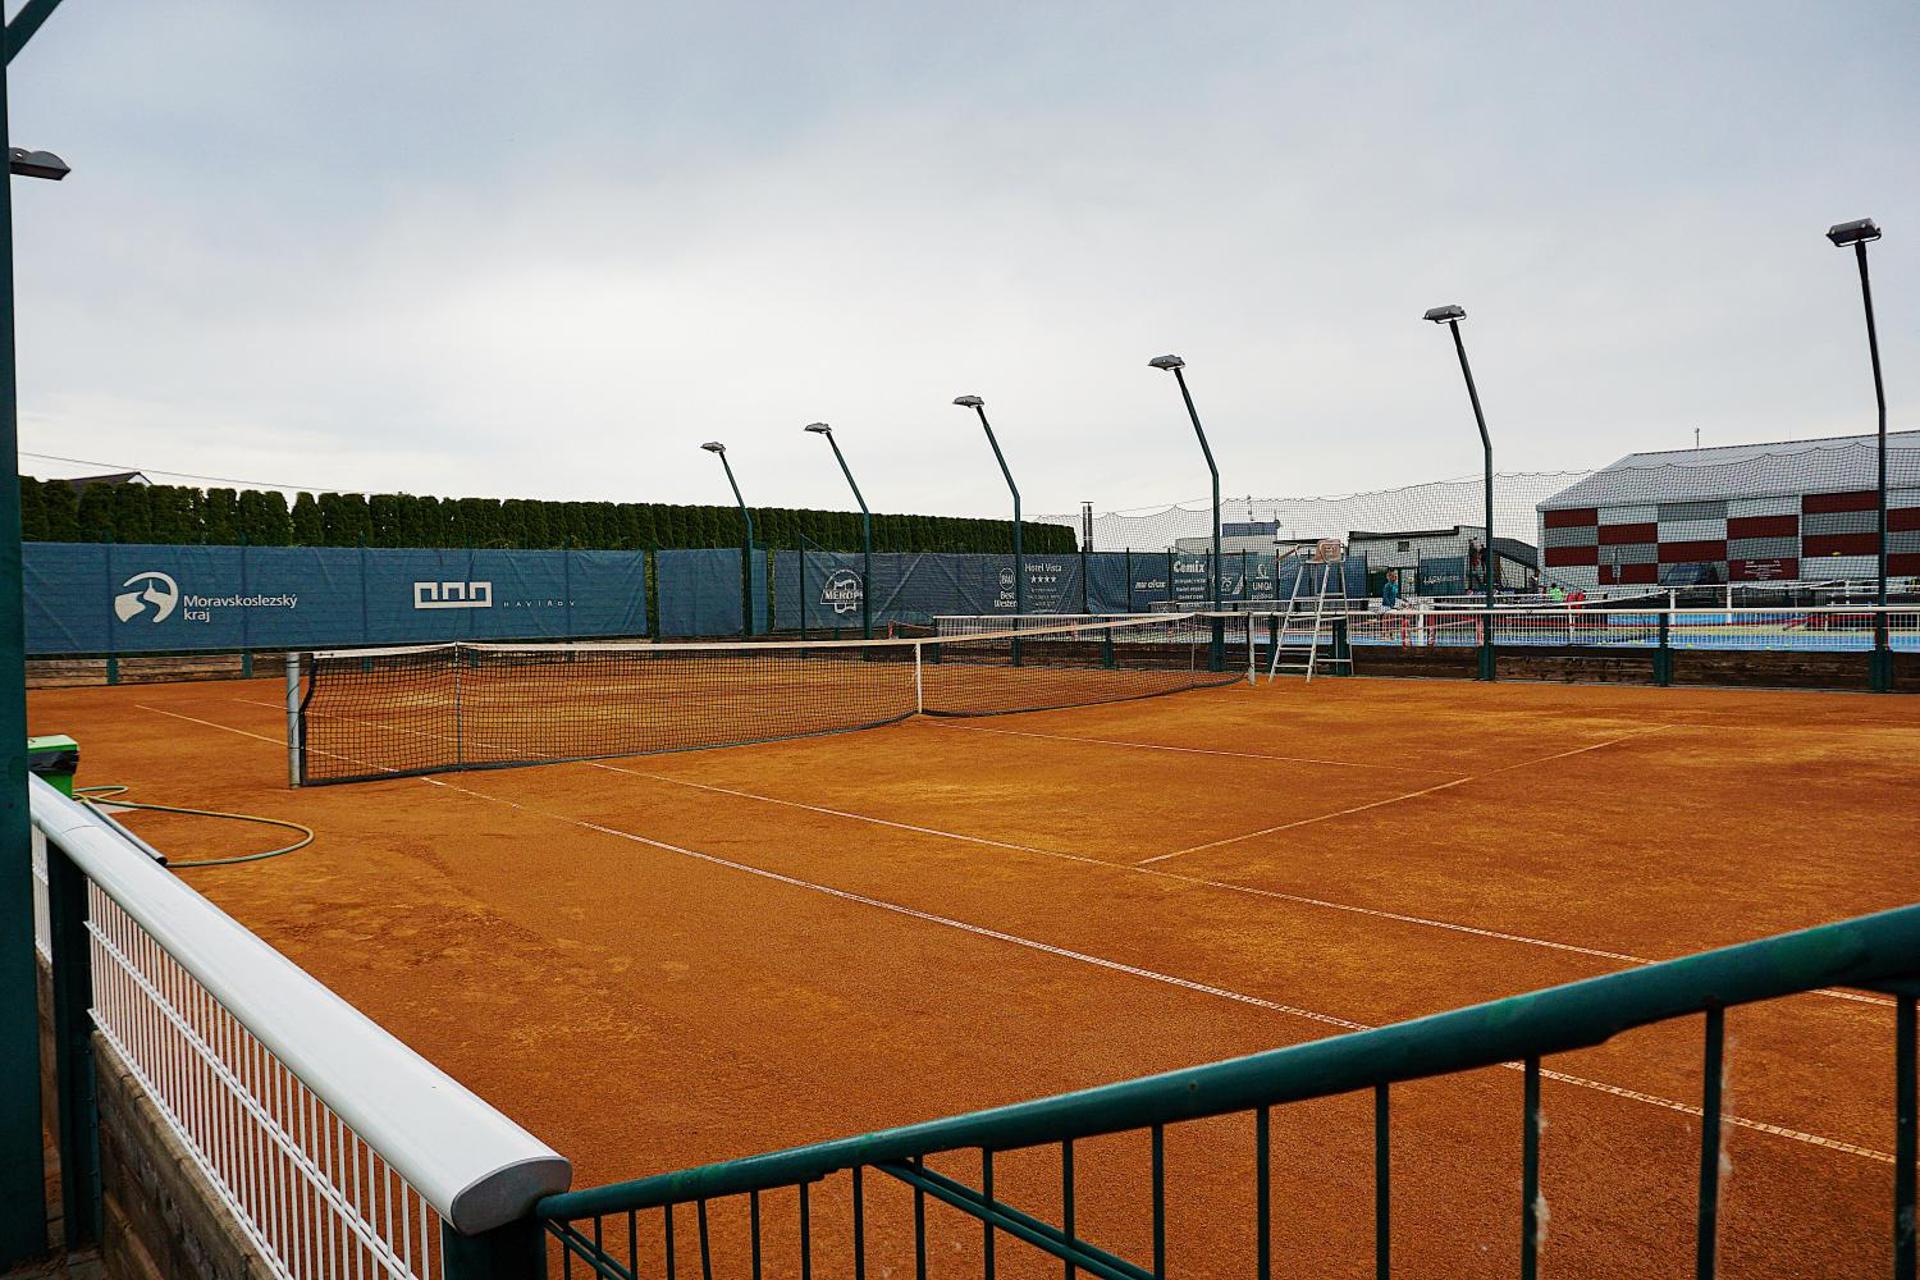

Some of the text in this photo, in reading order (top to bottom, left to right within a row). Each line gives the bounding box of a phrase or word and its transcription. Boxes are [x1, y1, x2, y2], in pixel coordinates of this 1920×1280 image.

[1024, 563, 1062, 572] Hotel Vista
[1173, 560, 1206, 573] Cemix
[183, 593, 298, 608] Moravskoslezský
[1000, 590, 1015, 600] Best
[183, 608, 210, 622] kraj
